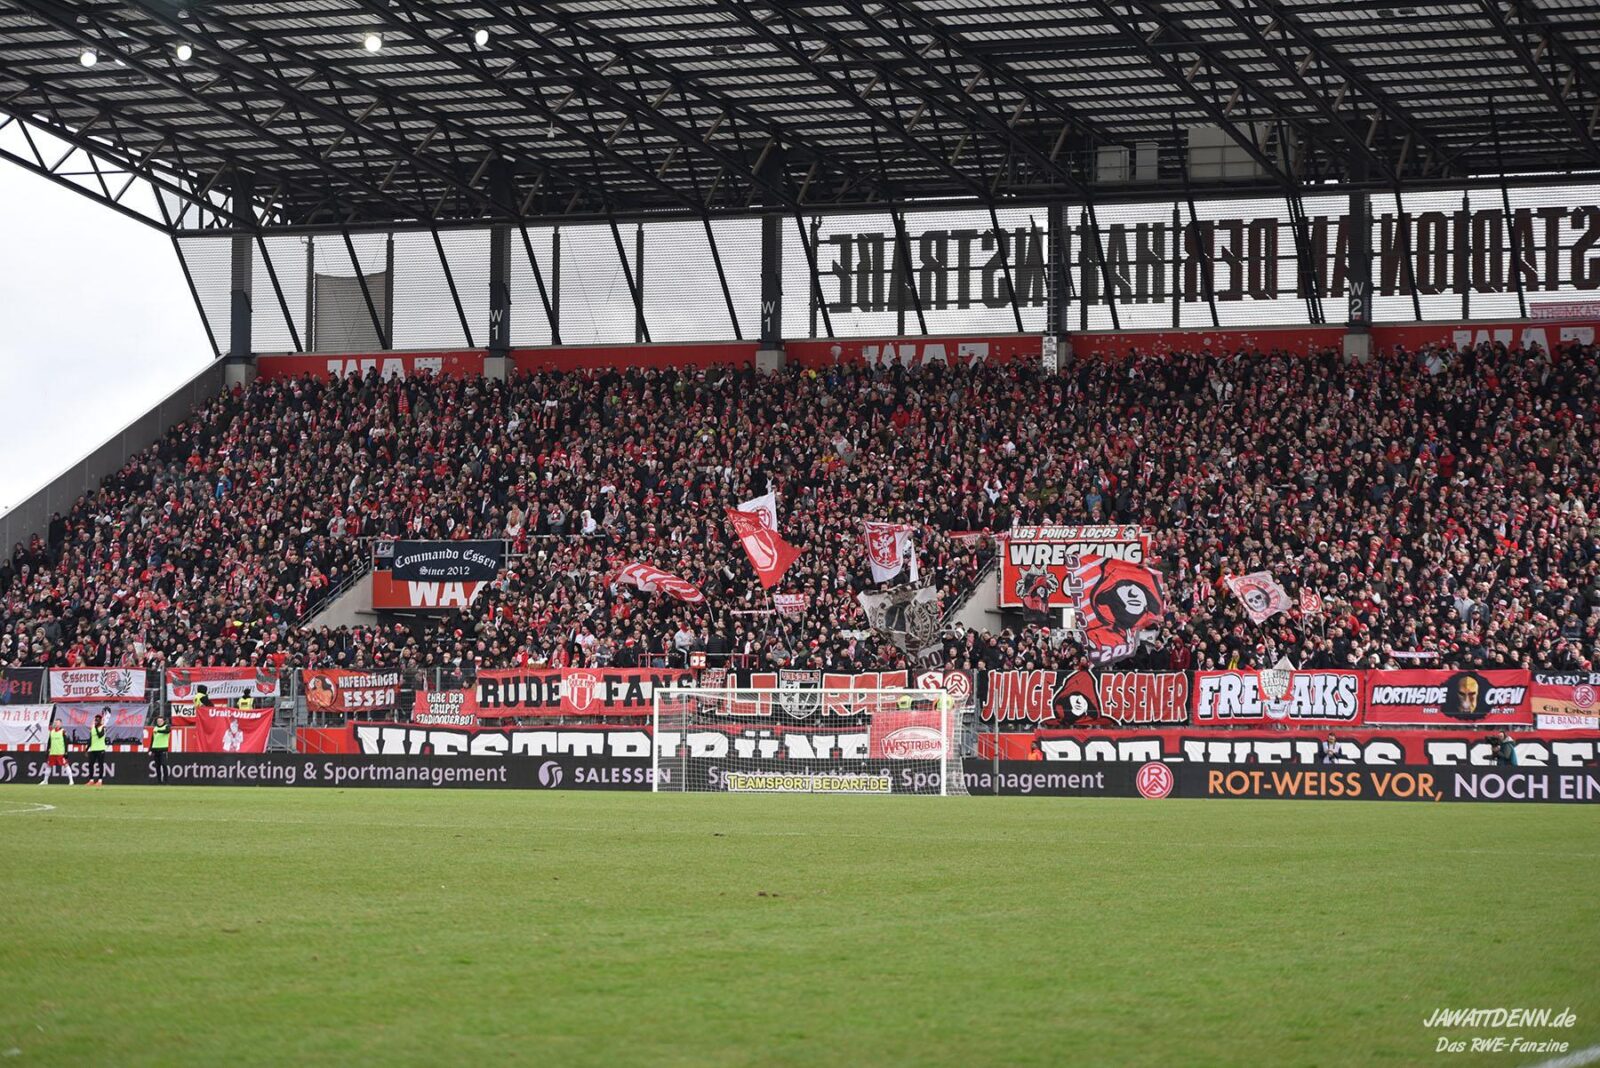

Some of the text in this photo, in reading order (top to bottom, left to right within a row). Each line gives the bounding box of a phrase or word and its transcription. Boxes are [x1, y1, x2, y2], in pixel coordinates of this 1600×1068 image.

[1349, 282, 1364, 295] W
[761, 300, 776, 314] W
[1350, 299, 1362, 314] 2
[489, 309, 503, 322] W
[1013, 527, 1036, 539] LOS
[1080, 527, 1119, 539] LOCOS
[394, 548, 497, 569] Commando Essen
[419, 566, 471, 576] Since 2012
[61, 671, 101, 684] Essener
[338, 672, 398, 688] HAFENSÄNGER
[62, 684, 100, 697] Jungs
[343, 688, 395, 707] ESSEN
[478, 673, 562, 709] RUDE
[603, 673, 695, 708] FANS
[981, 670, 1189, 723] JUNGE ESSENER
[1371, 685, 1526, 705] NORTHSIDE CREW
[449, 692, 464, 704] DER
[429, 703, 460, 714] GRUPPE
[303, 762, 317, 780] &
[323, 762, 507, 786] Sportmanagement
[1208, 770, 1361, 797] ROT-WEISS
[1371, 771, 1444, 801] VOR,
[1454, 773, 1549, 800] NOCH
